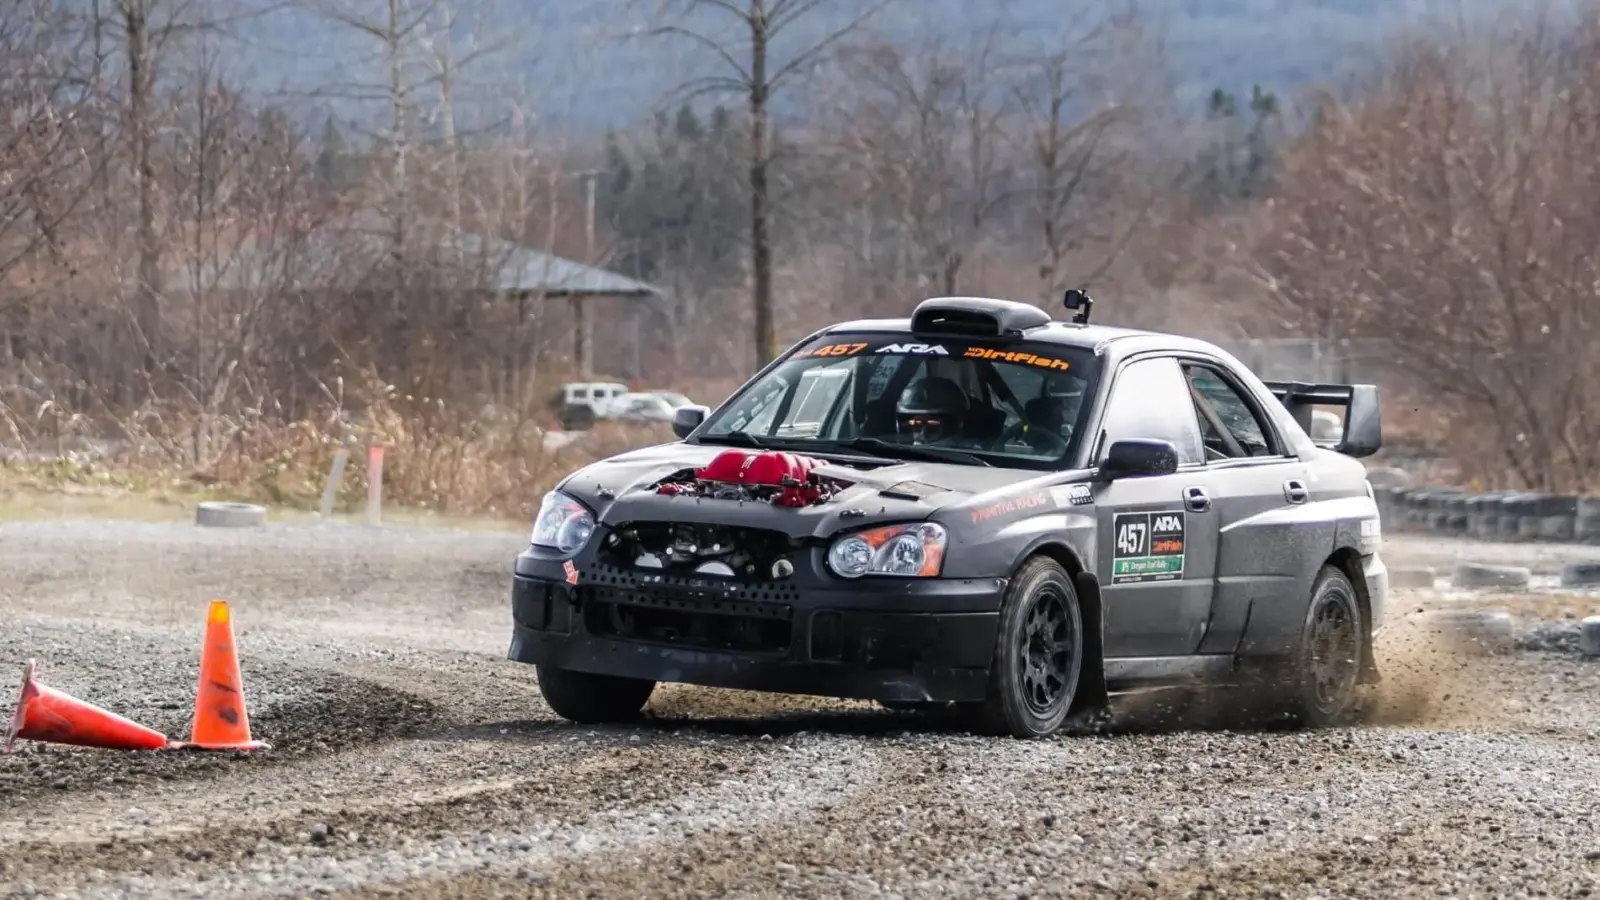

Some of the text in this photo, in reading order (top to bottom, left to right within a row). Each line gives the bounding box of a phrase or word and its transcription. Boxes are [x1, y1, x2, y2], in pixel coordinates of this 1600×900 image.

[813, 342, 868, 356] 457
[875, 343, 949, 355] ARA
[1016, 492, 1047, 509] RACING
[1153, 516, 1182, 531] ARA
[1117, 523, 1146, 553] 457
